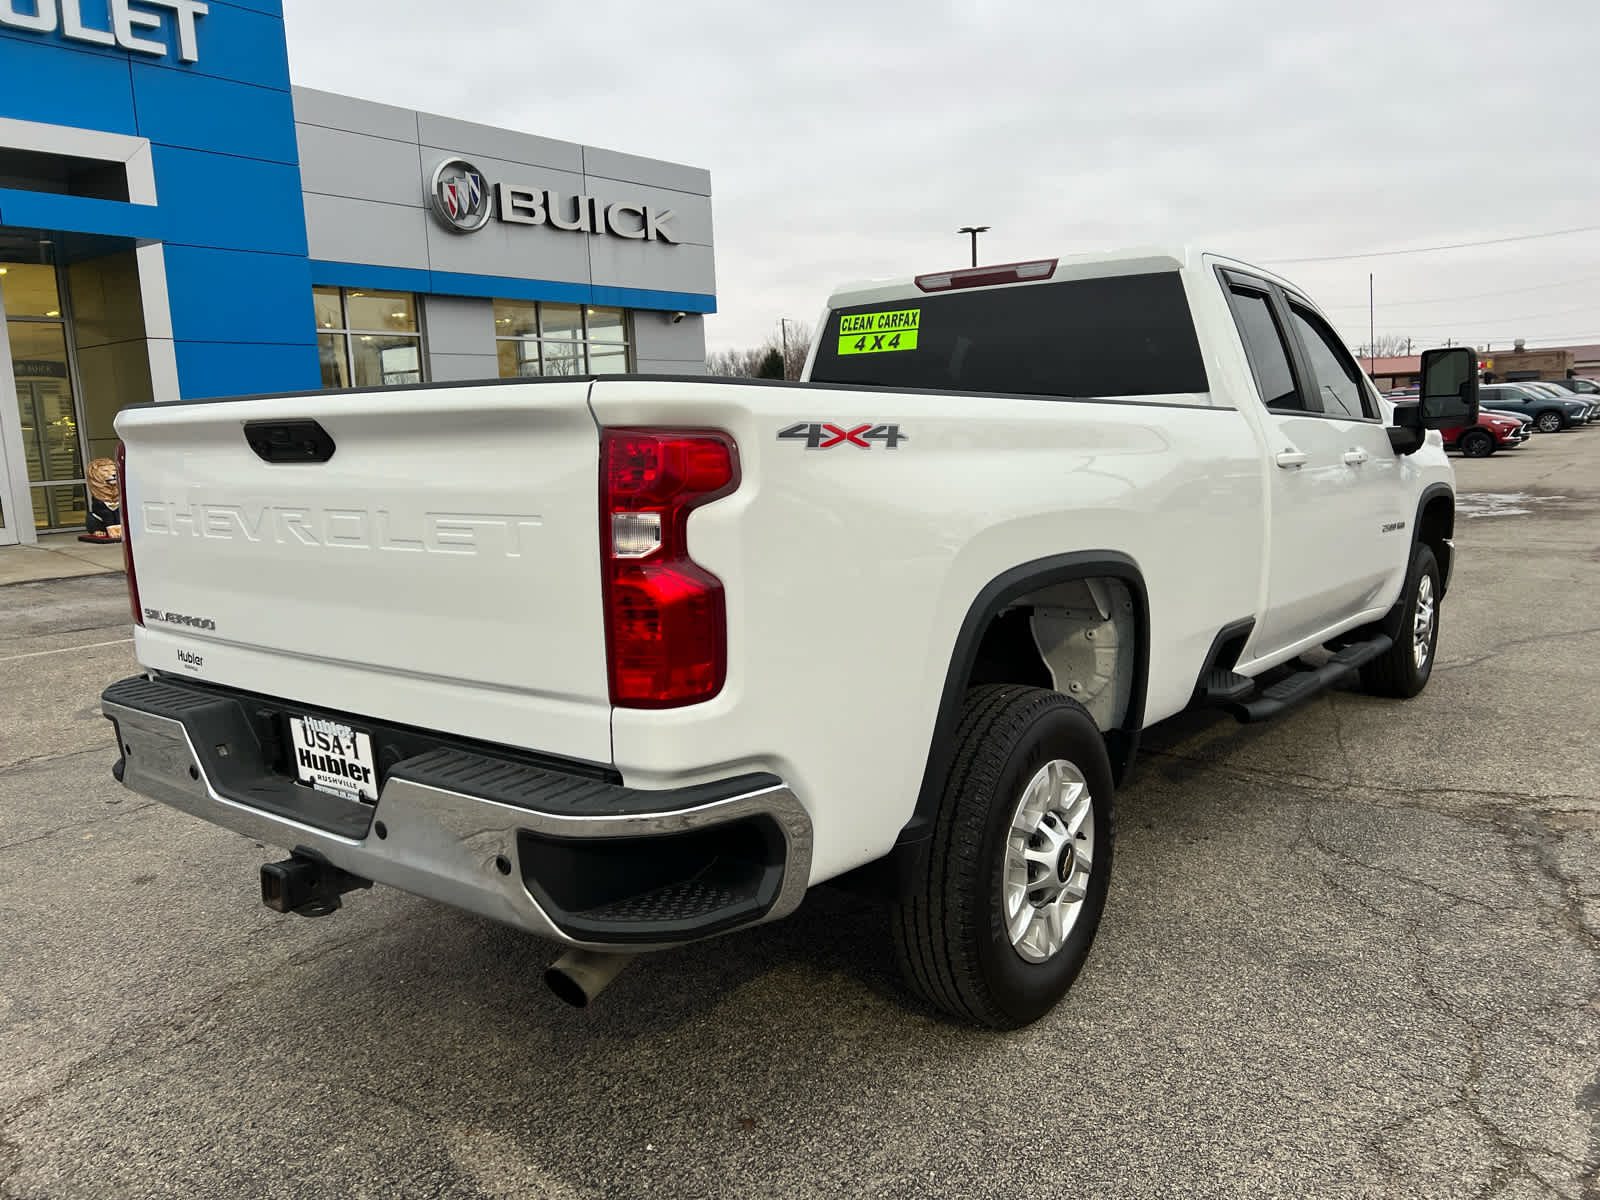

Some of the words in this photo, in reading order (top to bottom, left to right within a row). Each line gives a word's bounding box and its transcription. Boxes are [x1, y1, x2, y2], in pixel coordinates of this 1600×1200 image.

[495, 182, 680, 245] BUICK
[841, 315, 875, 332] CLEAN
[877, 311, 919, 329] CARFAX
[142, 500, 543, 558] CHEVROLET
[177, 649, 204, 666] Hubler
[298, 747, 371, 784] Hubler
[316, 774, 359, 790] RUSHVILLE
